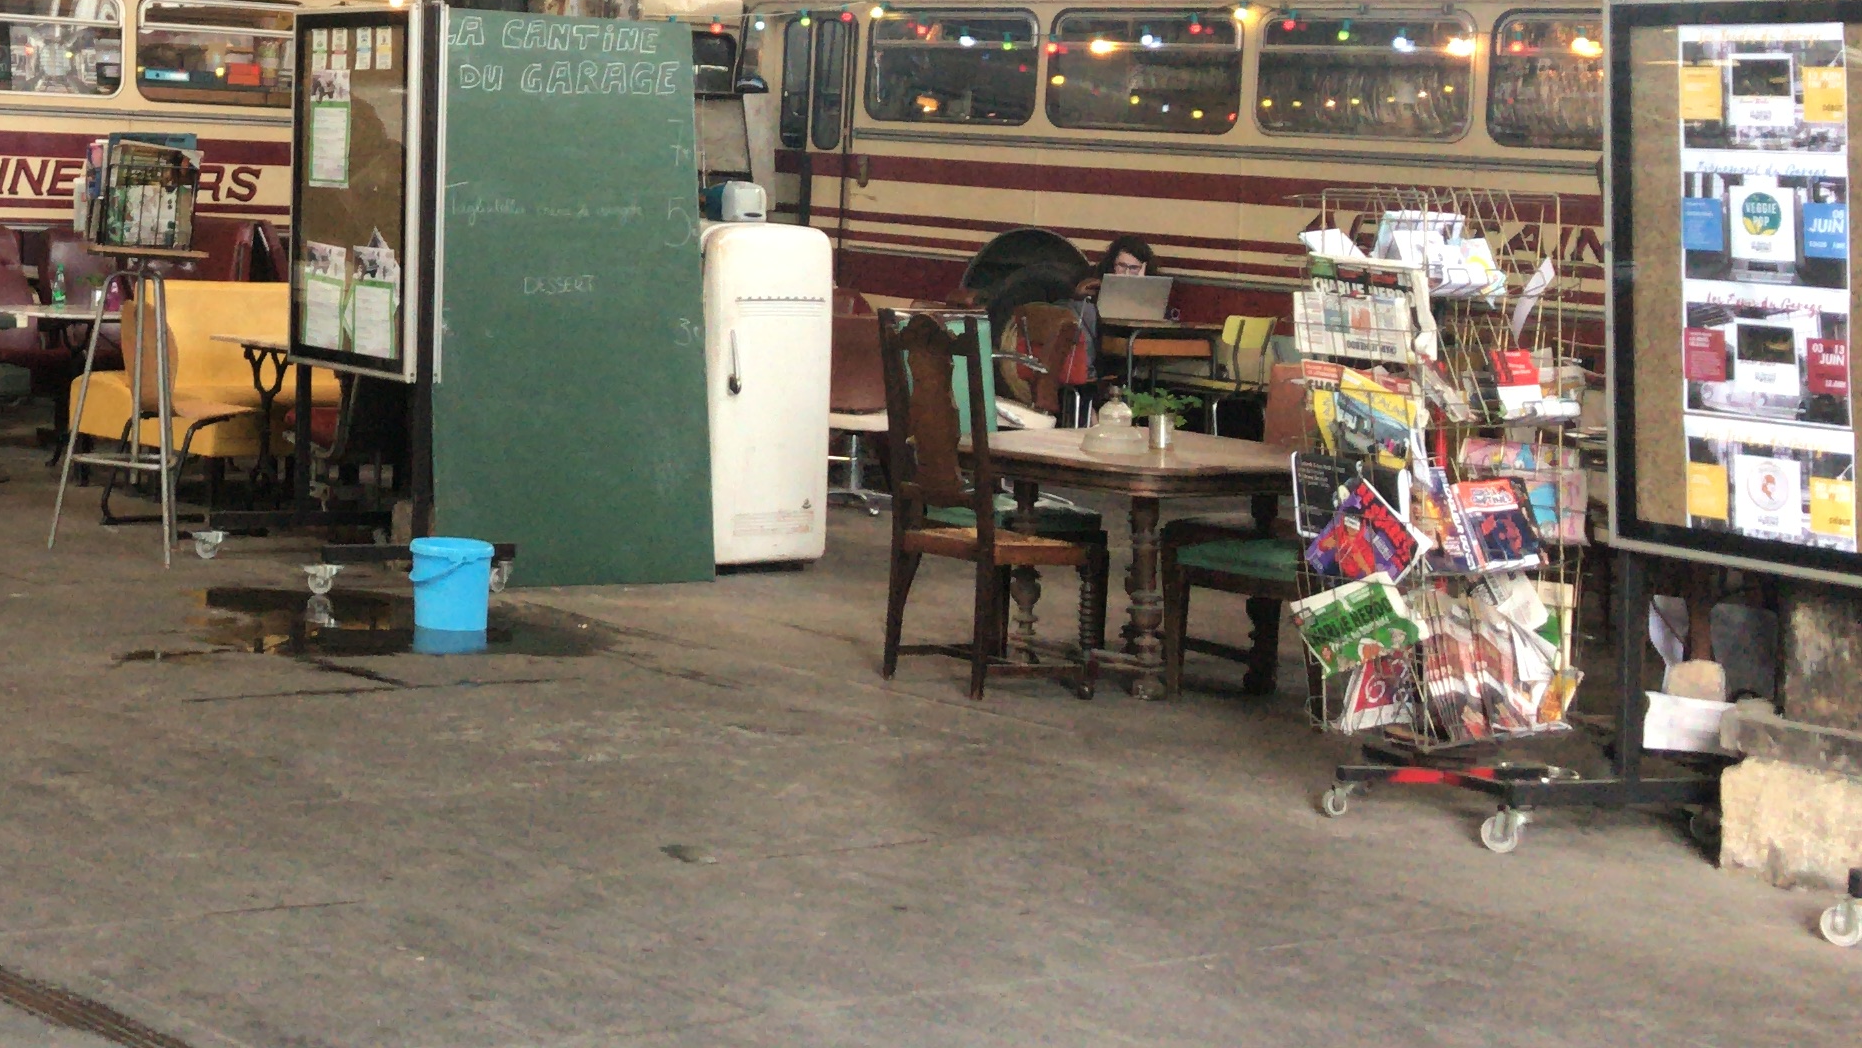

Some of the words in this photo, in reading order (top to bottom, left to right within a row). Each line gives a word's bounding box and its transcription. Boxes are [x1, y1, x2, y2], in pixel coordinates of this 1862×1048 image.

[459, 63, 504, 92] DU
[520, 59, 681, 96] GARAGE
[1807, 217, 1845, 234] JUIN
[1818, 352, 1845, 367] JUIN
